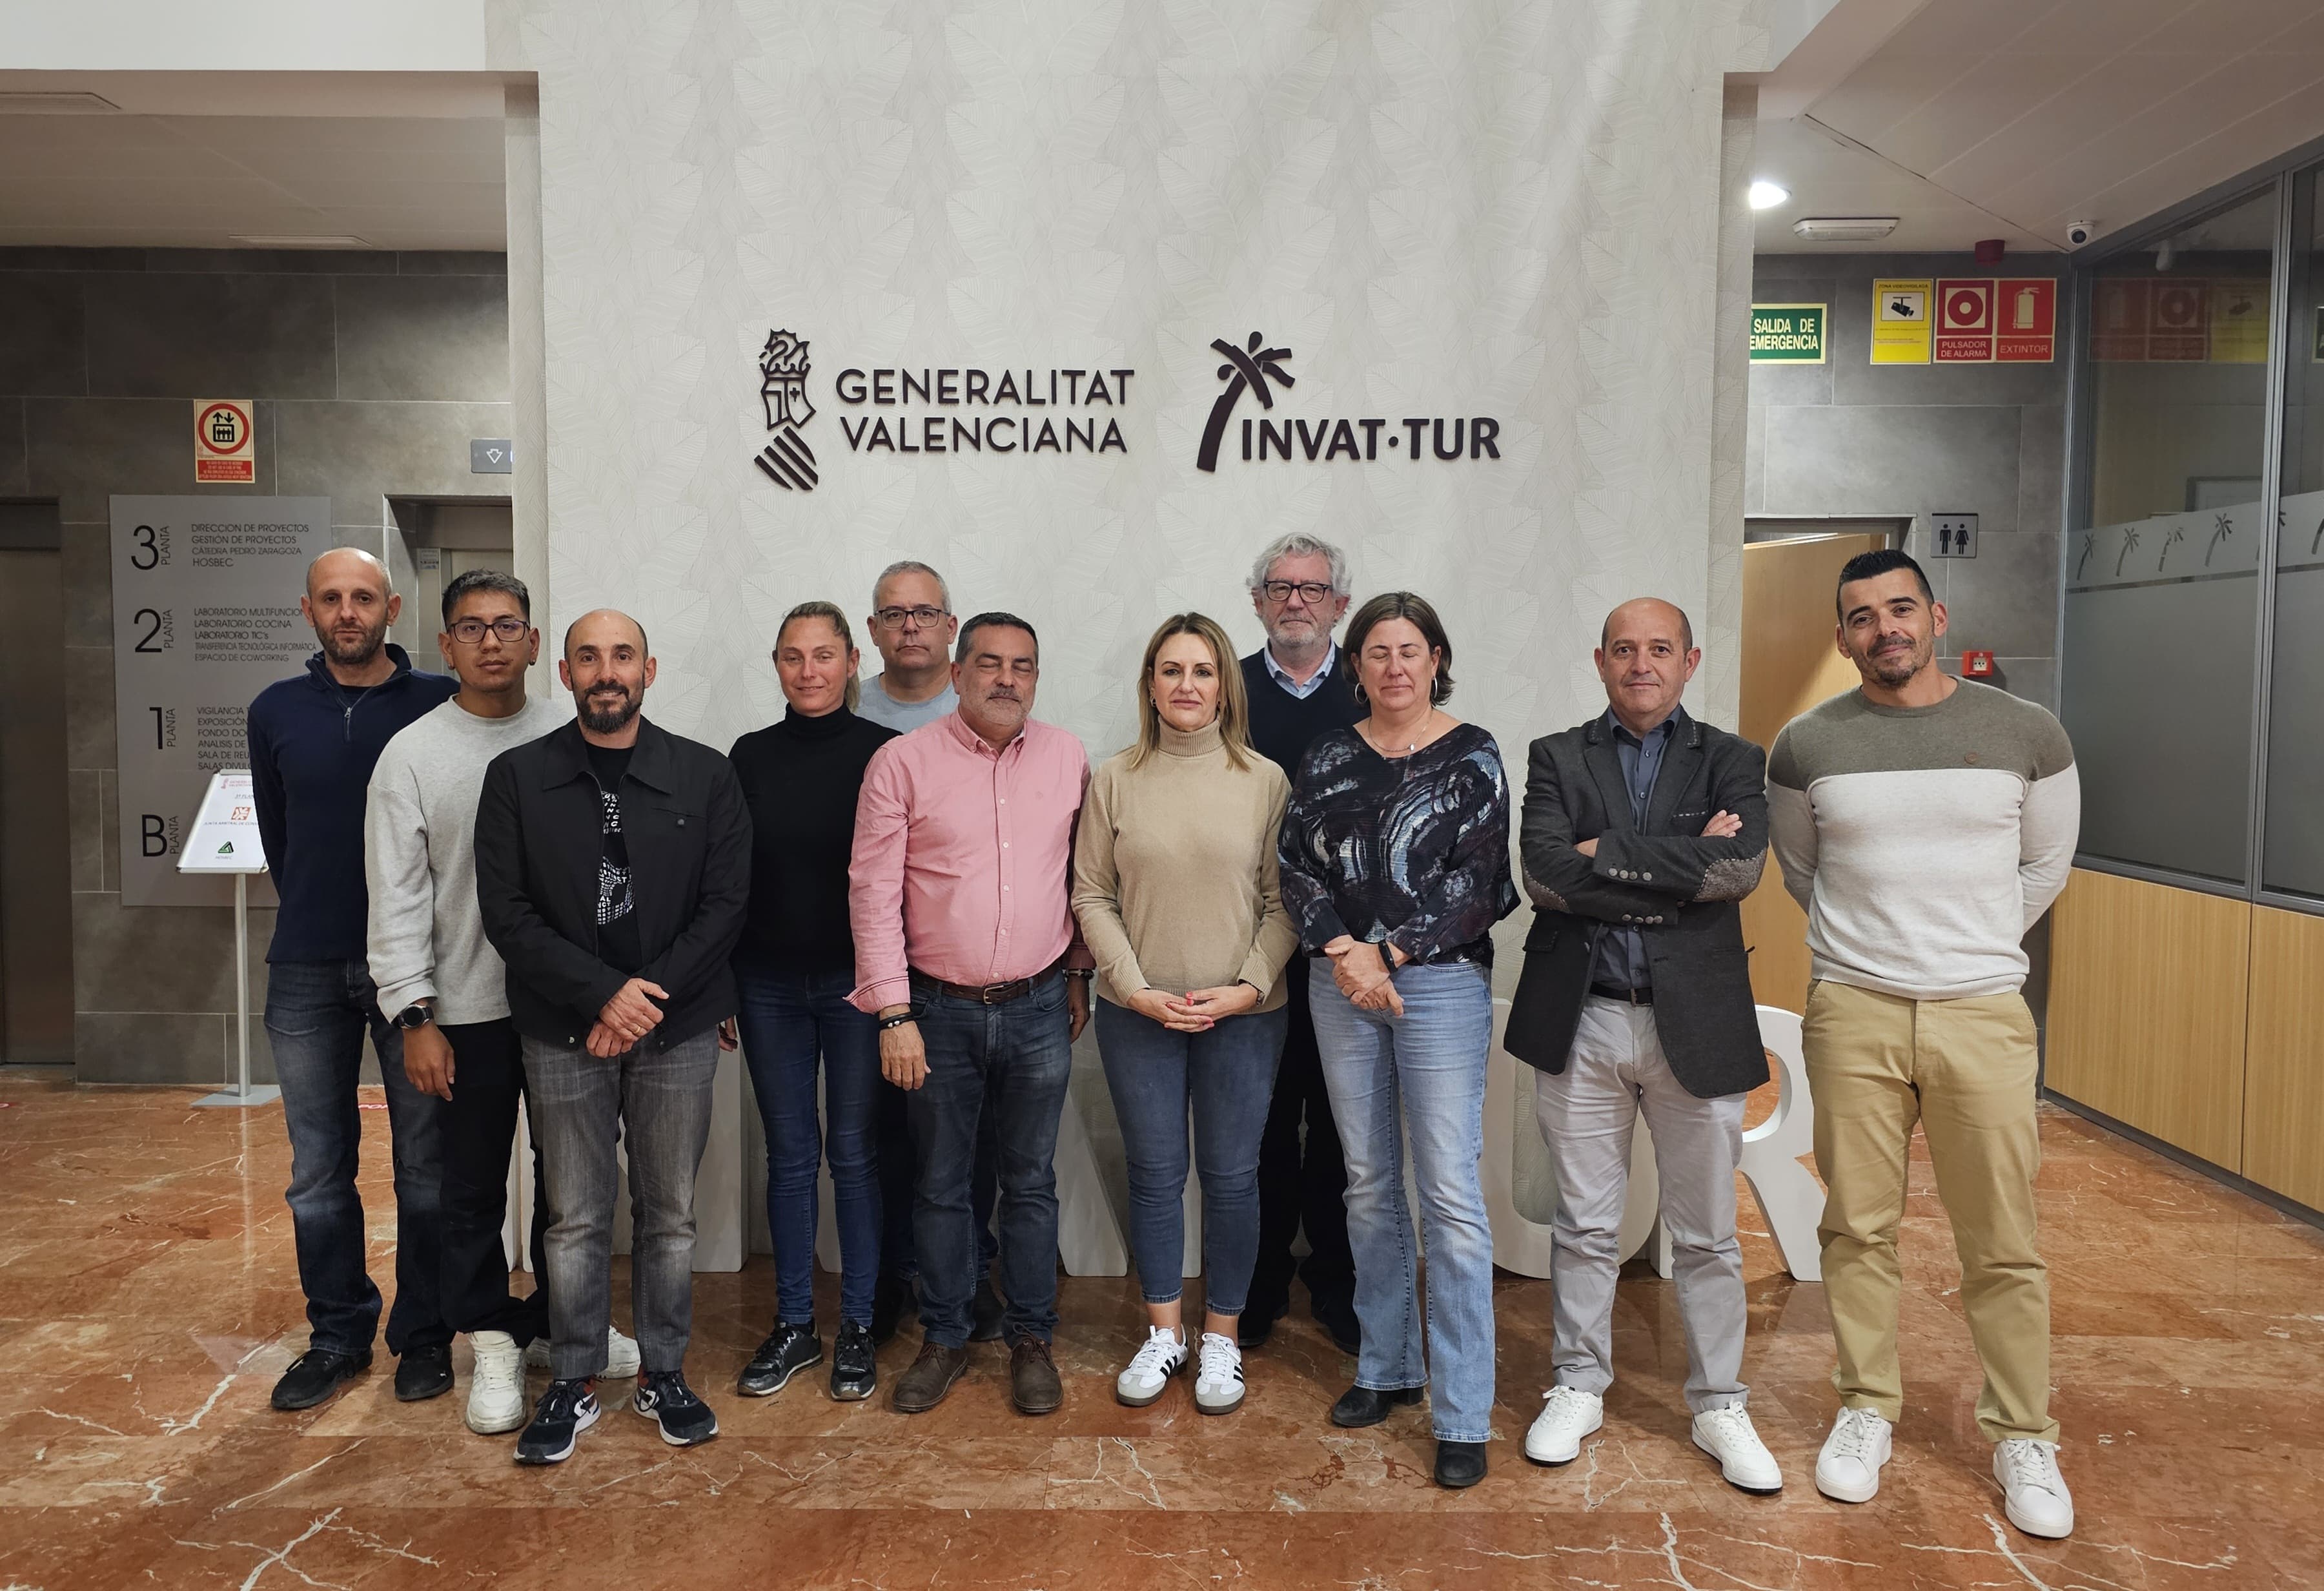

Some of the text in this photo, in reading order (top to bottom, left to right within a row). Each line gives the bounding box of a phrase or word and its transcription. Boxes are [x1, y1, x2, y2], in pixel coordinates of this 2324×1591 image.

[1753, 318, 1815, 333] SALIDA DE
[1749, 334, 1819, 350] EMERGENCIA
[2000, 345, 2048, 353] EXTINTOR
[835, 368, 1135, 405] GENERALITAT
[839, 416, 1128, 453] VALENCIANA
[231, 535, 243, 544] DE
[245, 535, 297, 544] PROYECTOS
[244, 524, 255, 532] DE
[258, 524, 309, 533] PROYECTOS
[131, 525, 159, 570] 3
[160, 525, 171, 566] PLANTA
[258, 547, 302, 555] ZARAGOZA
[192, 558, 234, 567] HOSBEC
[134, 608, 162, 652] 2
[163, 609, 174, 648] PLANTA
[194, 620, 292, 628] LABORATORIO COCINA
[195, 631, 249, 639] LABORATORIO
[240, 653, 289, 662] COWORKING
[149, 707, 163, 750] 1
[166, 708, 176, 747] PLANTA
[141, 814, 167, 857] B
[170, 816, 179, 854] PLANTA
